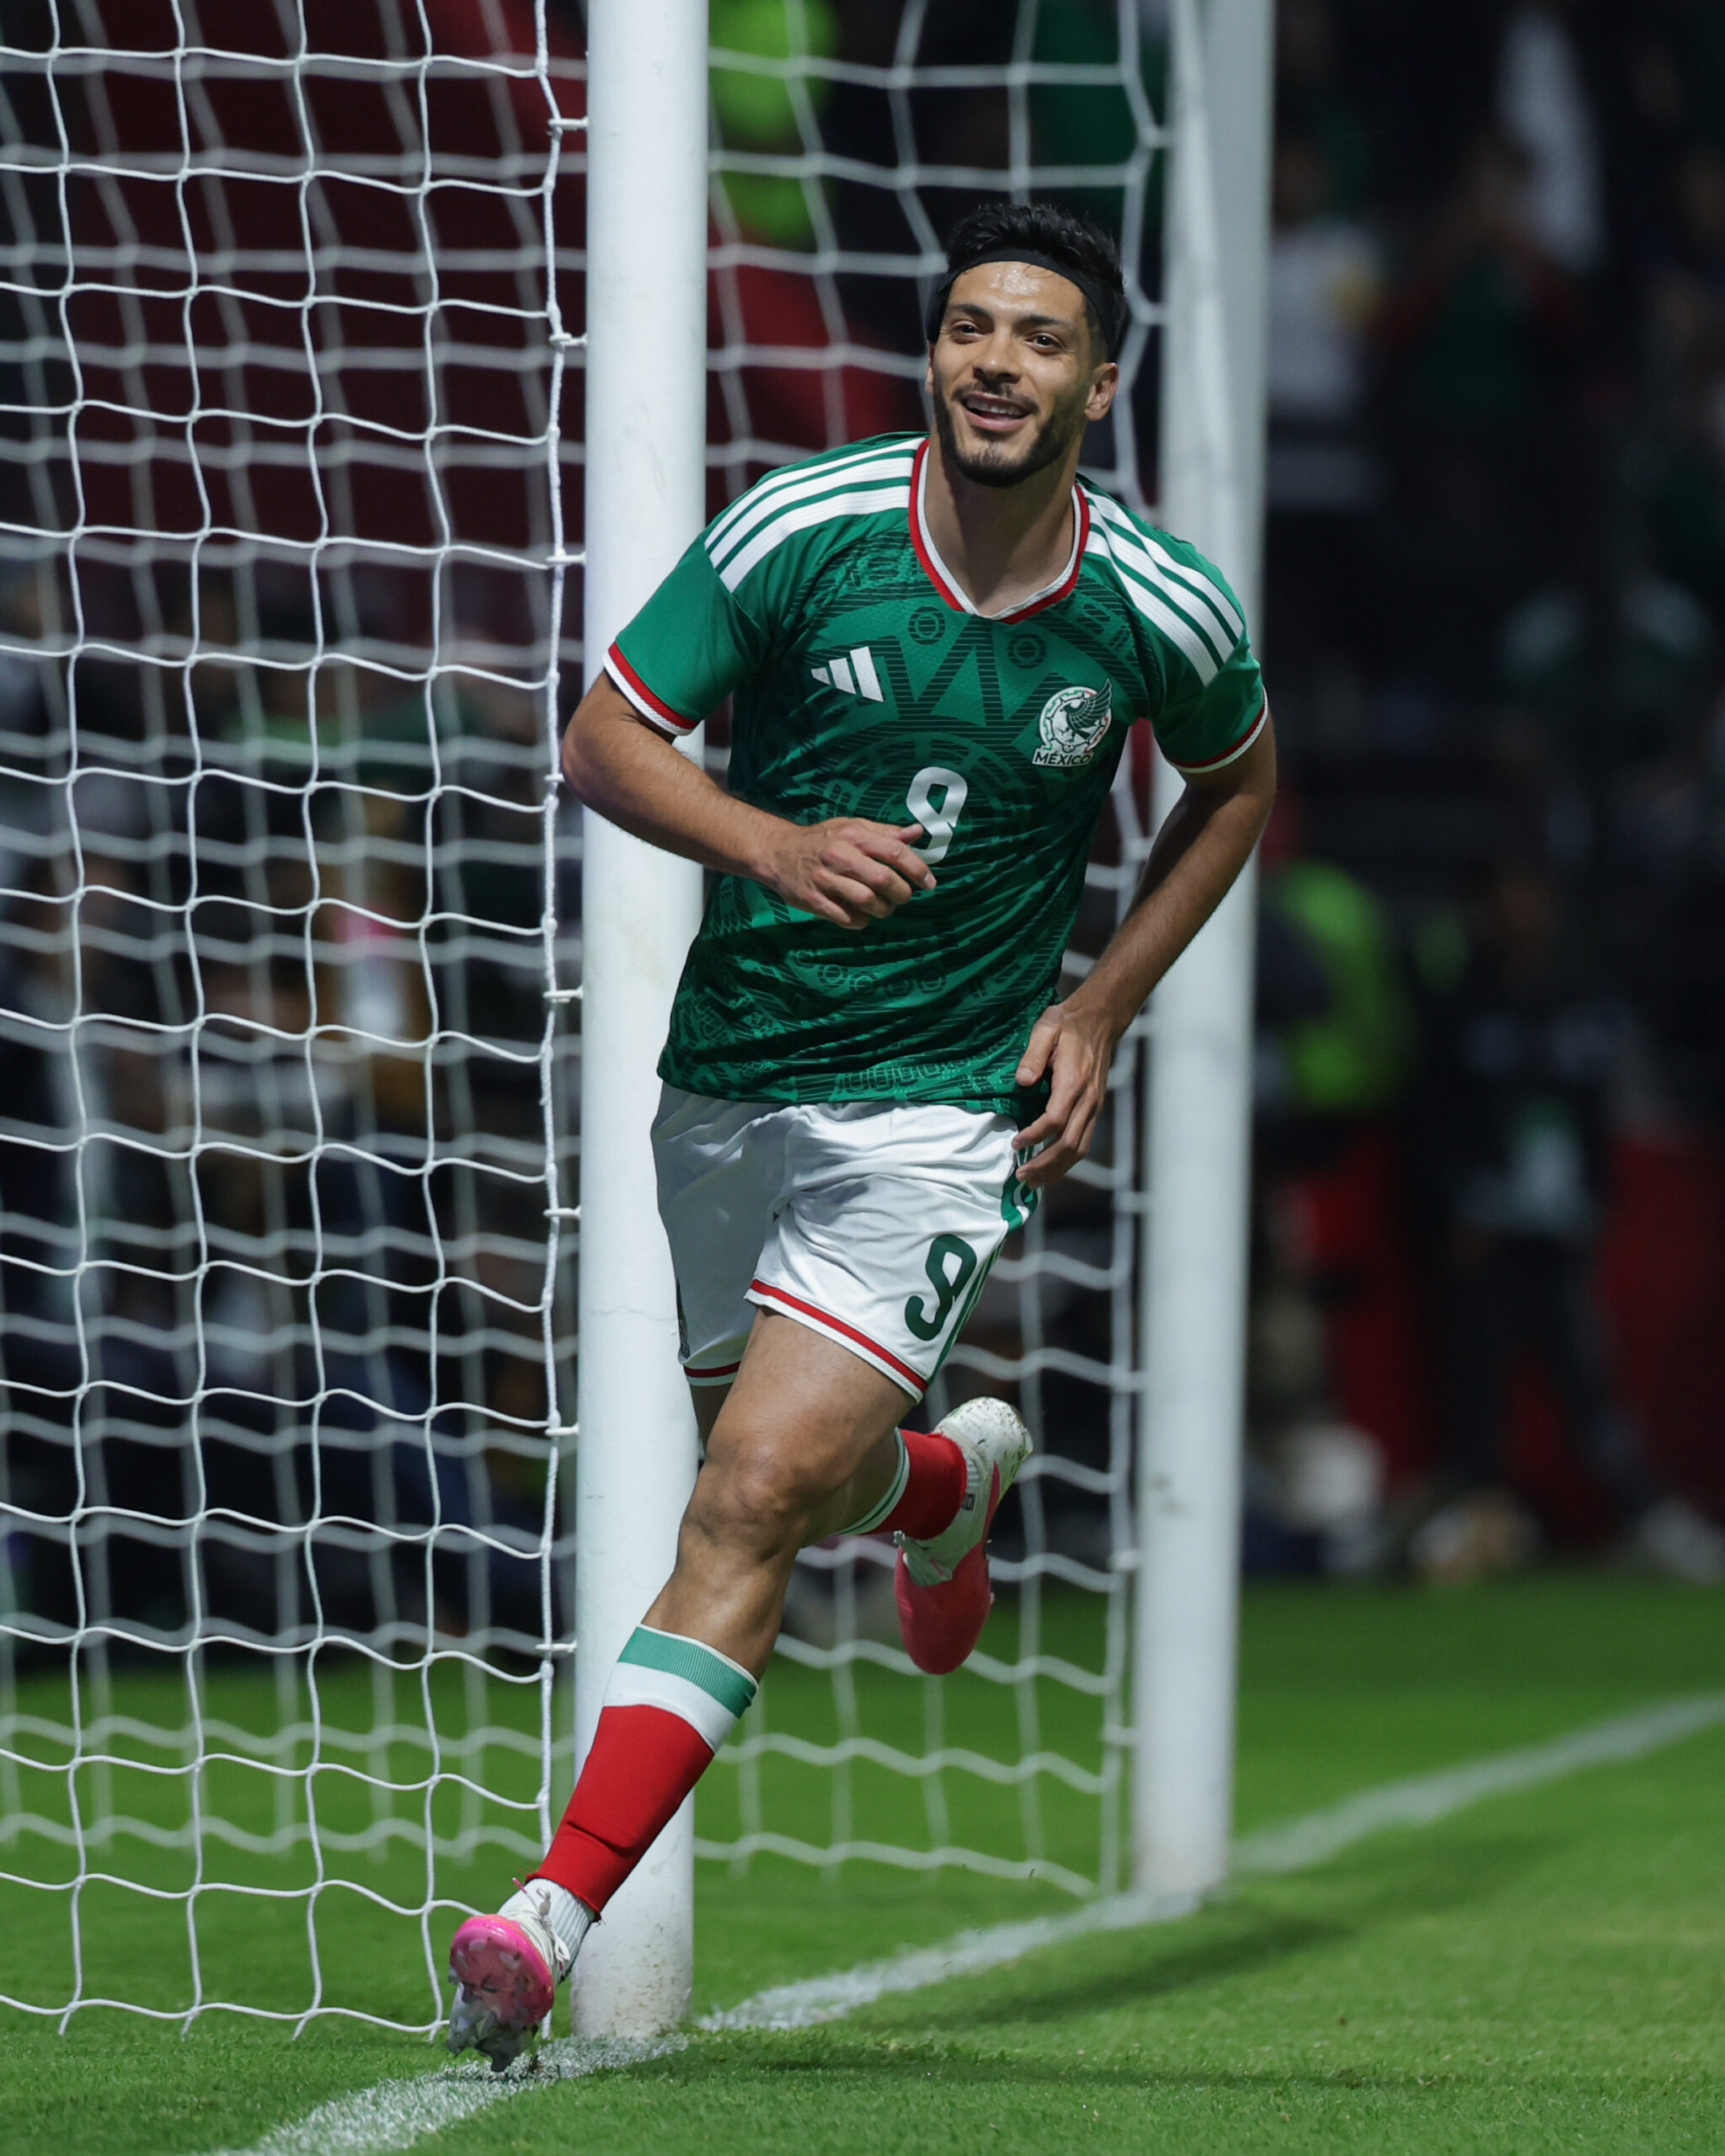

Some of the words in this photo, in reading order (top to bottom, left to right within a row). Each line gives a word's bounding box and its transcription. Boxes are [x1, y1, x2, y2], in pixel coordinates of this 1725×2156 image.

[1034, 750, 1092, 766] MÉXICO
[905, 766, 968, 865] 9
[905, 1234, 977, 1341] 9
